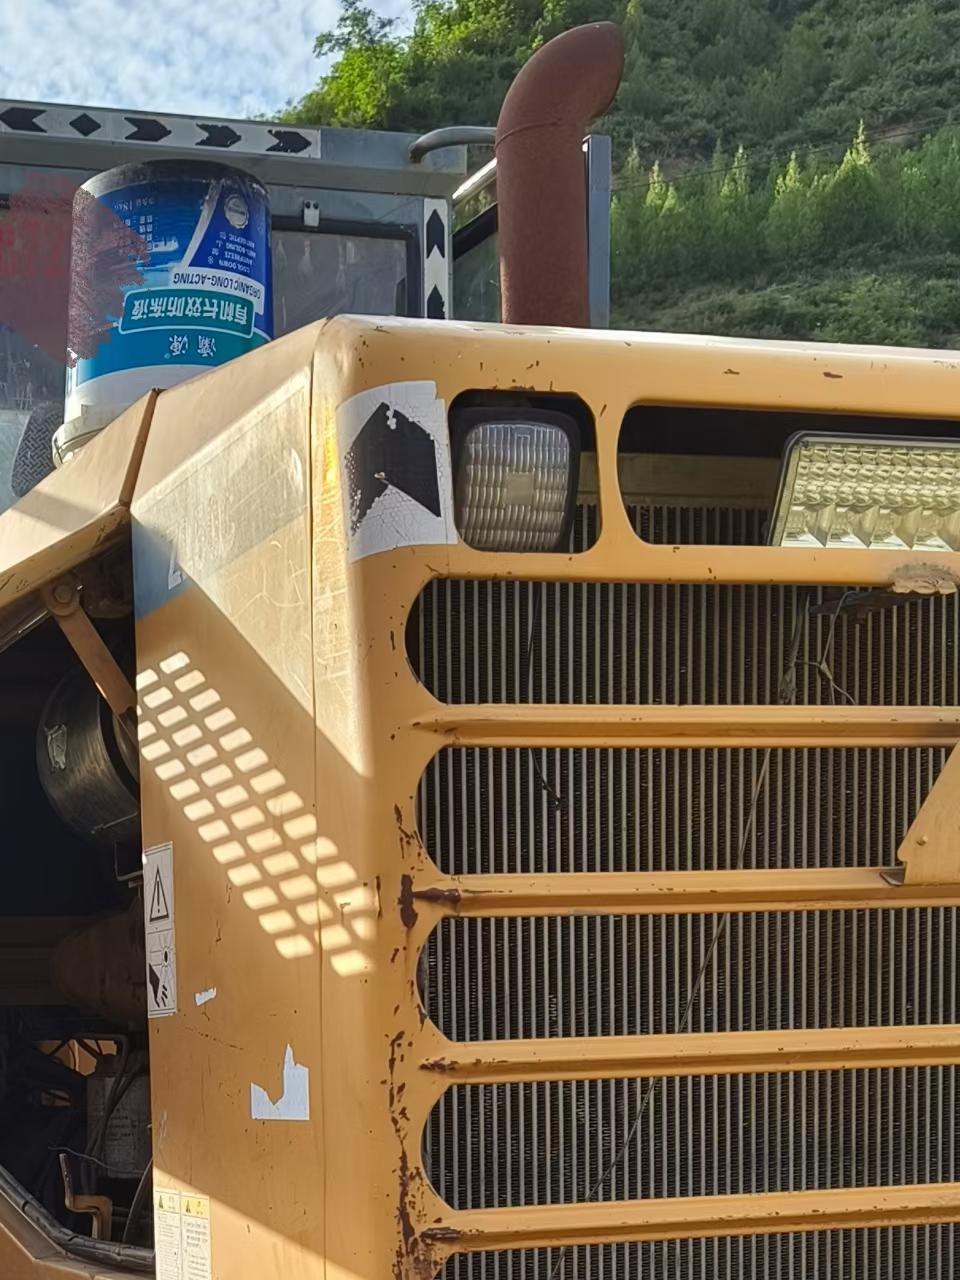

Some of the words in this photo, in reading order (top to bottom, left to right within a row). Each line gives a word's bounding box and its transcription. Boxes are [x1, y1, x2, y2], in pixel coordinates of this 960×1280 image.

[173, 272, 234, 289] LONG-ACTING
[233, 279, 261, 300] ORGANIC
[131, 297, 248, 325] 有机长效防冻液
